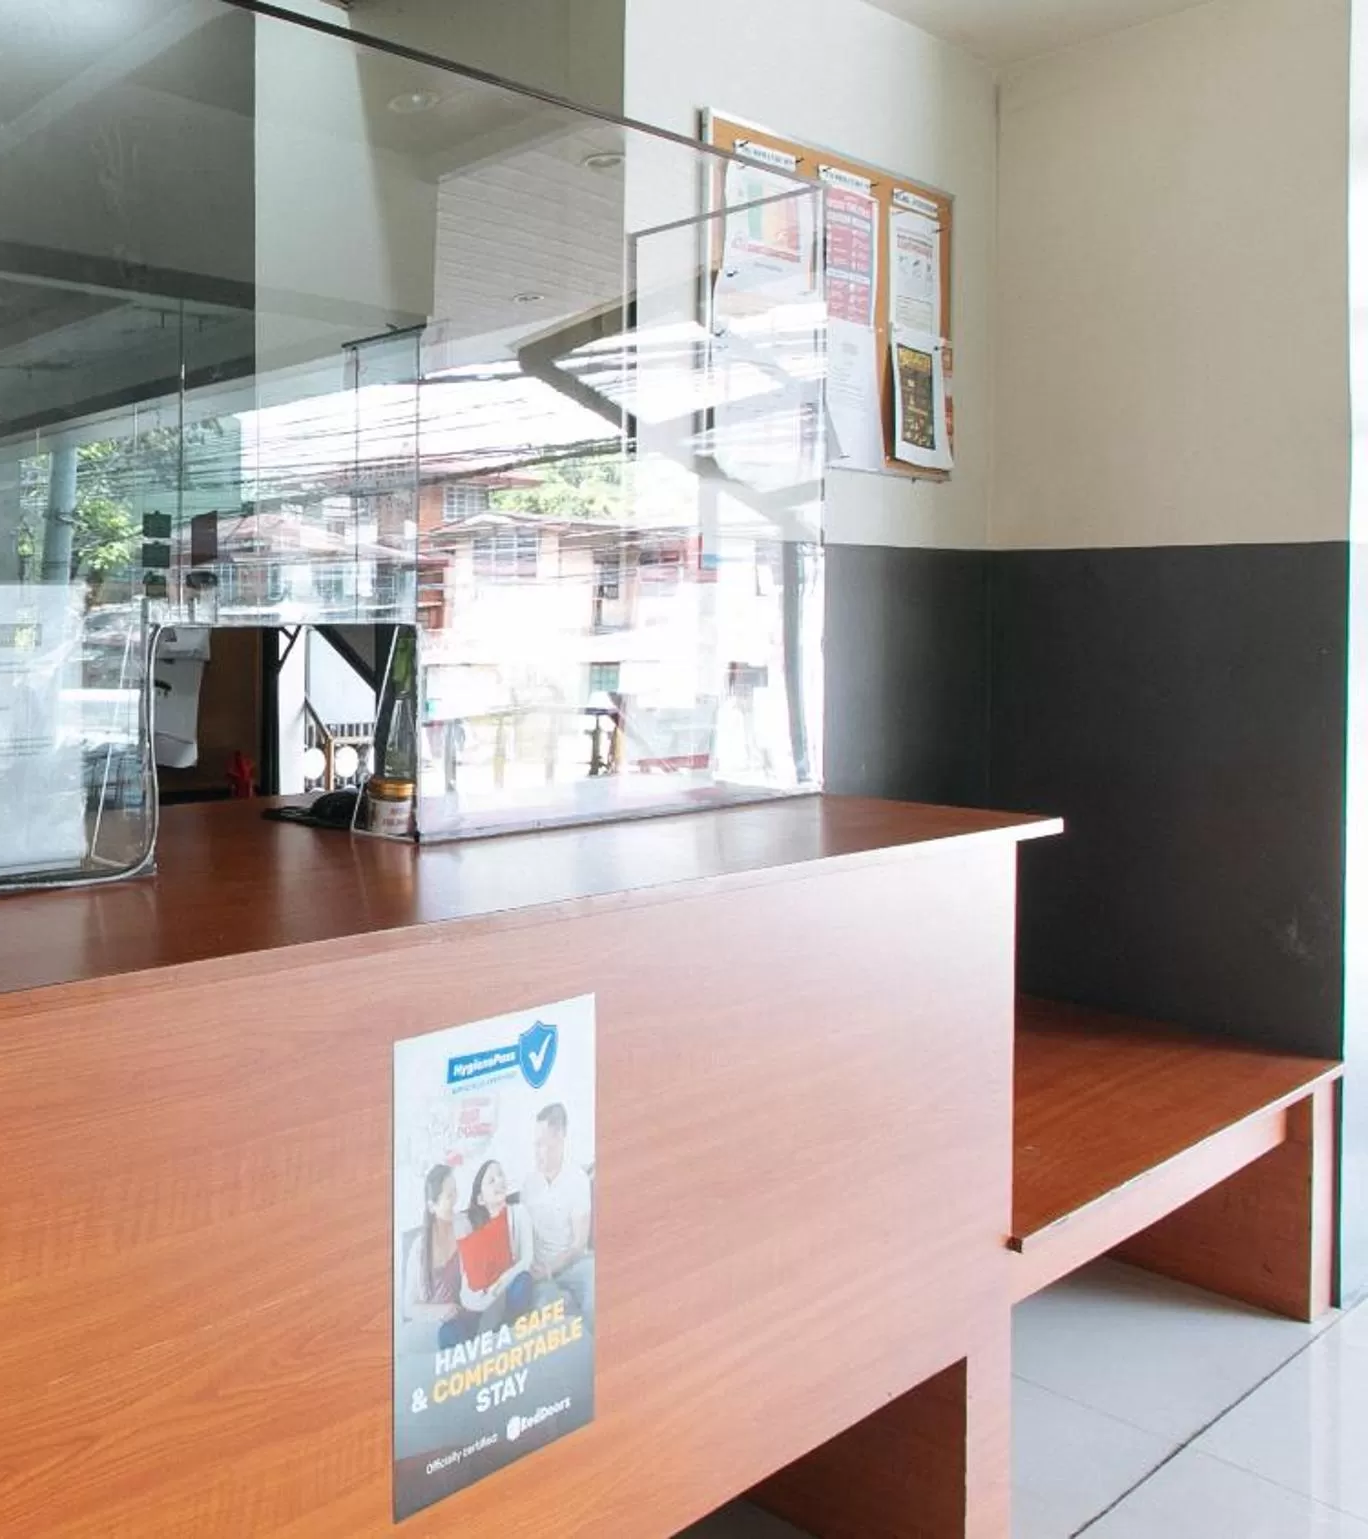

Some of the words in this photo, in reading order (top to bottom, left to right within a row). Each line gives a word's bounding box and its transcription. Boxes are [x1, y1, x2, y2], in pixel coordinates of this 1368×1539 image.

[411, 1387, 428, 1413] &
[433, 1316, 583, 1404] COMFORTABLE
[435, 1330, 493, 1375] HAVE
[497, 1323, 513, 1350] A
[514, 1298, 565, 1339] SAFE
[475, 1368, 529, 1412] STAY
